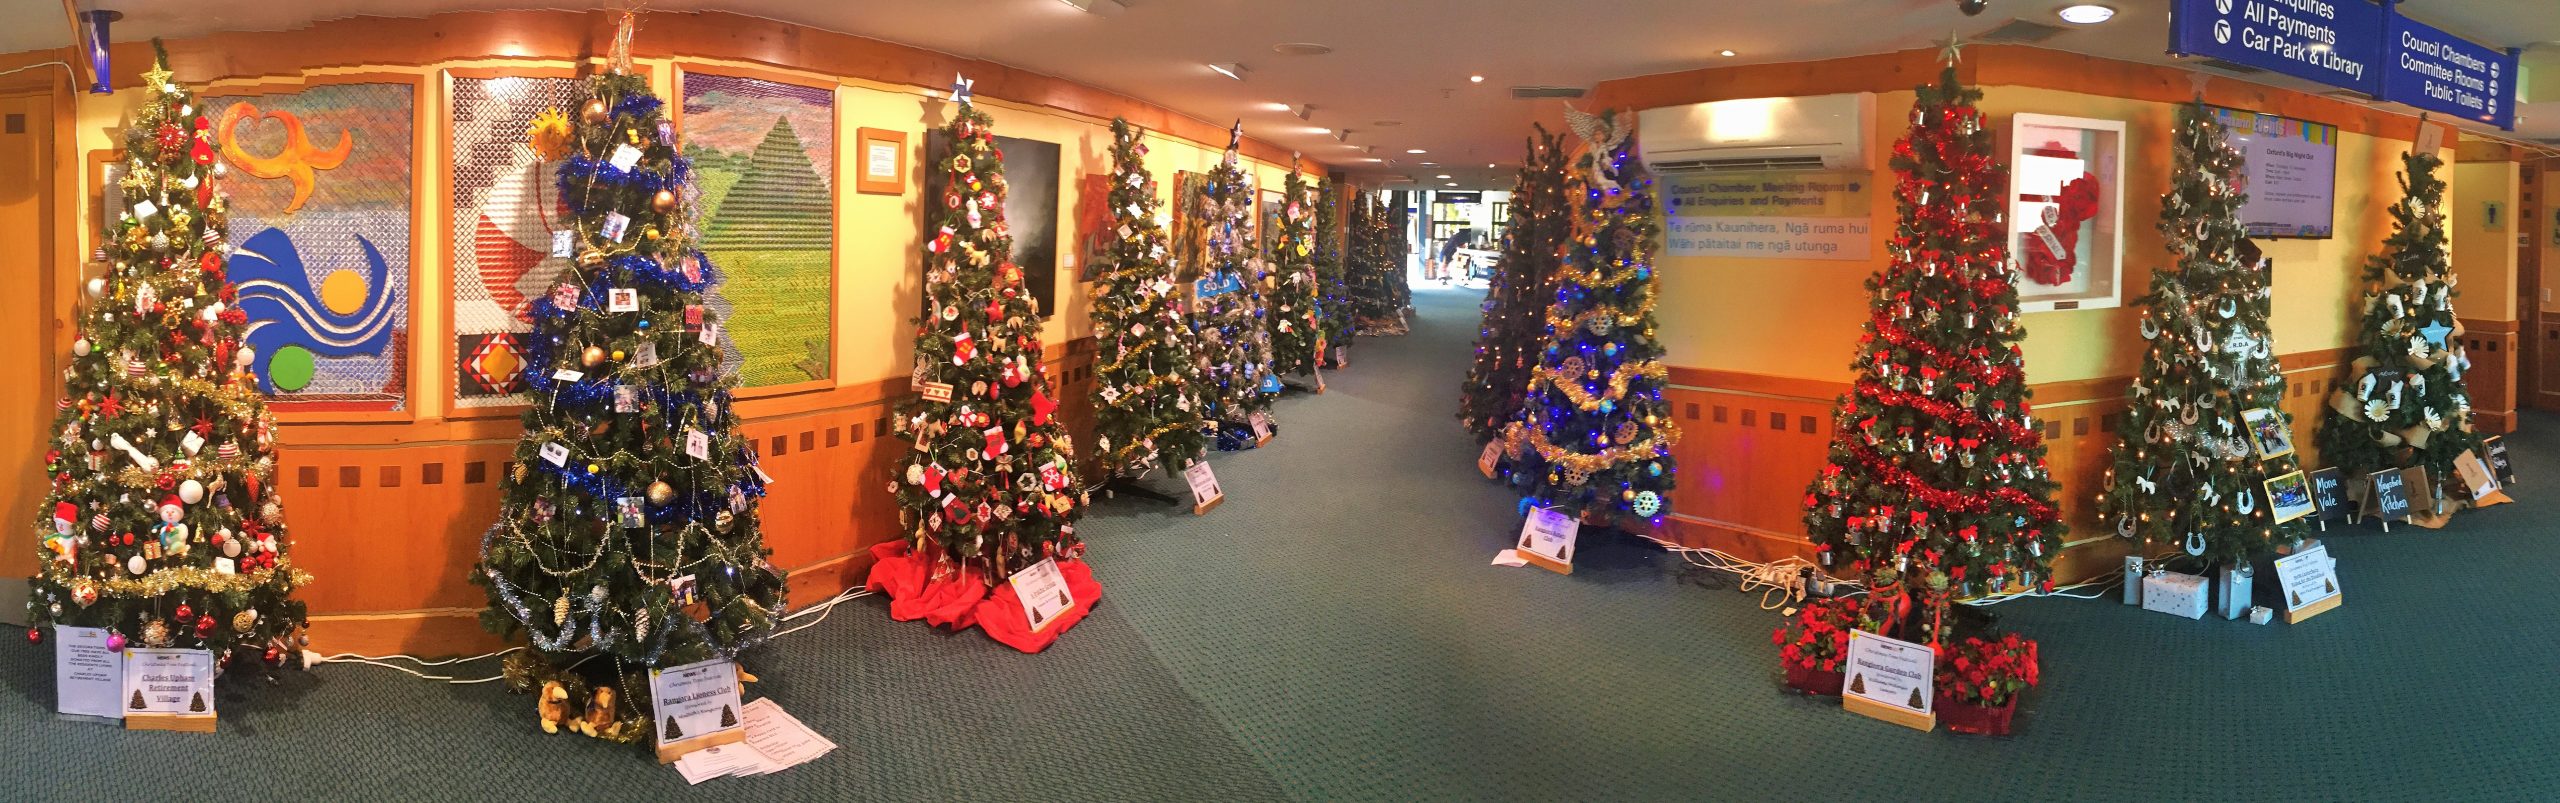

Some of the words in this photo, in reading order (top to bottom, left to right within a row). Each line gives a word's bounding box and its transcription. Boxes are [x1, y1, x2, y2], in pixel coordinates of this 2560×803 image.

[2244, 4, 2264, 24] All
[2268, 8, 2336, 44] Payments
[2242, 27, 2270, 52] Car
[2274, 36, 2305, 62] Park
[2308, 47, 2319, 65] &
[2323, 49, 2364, 80] Library
[2402, 31, 2440, 58] Council
[2442, 44, 2486, 72] Chambers
[2401, 52, 2454, 82] Committee
[2454, 69, 2484, 92] Rooms
[2424, 80, 2454, 102] Public
[2454, 89, 2484, 110] Toilets
[1671, 184, 1704, 194] Council
[1708, 183, 1758, 193] Chamber,
[1762, 182, 1804, 193] Meeting
[1808, 182, 1845, 192] Rooms
[1698, 196, 1744, 207] Enquiries
[1750, 196, 1768, 206] and
[1772, 196, 1824, 206] Payments
[1668, 222, 1682, 232] Te
[1716, 222, 1780, 234] Kaunihera,
[1785, 222, 1809, 236] Ngā
[1814, 225, 1844, 234] ruma
[1848, 222, 1868, 234] hui
[1746, 241, 1764, 250] me
[1768, 240, 1790, 252] ngā
[1794, 241, 1838, 254] utunga
[2316, 478, 2338, 494] Mona
[2318, 492, 2338, 512] Vale
[2380, 494, 2408, 514] Kitchen
[1857, 658, 1884, 670] Rangiora
[1885, 665, 1908, 676] Garden
[1908, 670, 1922, 680] Club
[156, 695, 180, 703] Village
[664, 695, 691, 706] Rangiora
[692, 690, 717, 700] Lioness
[718, 686, 732, 694] Club
